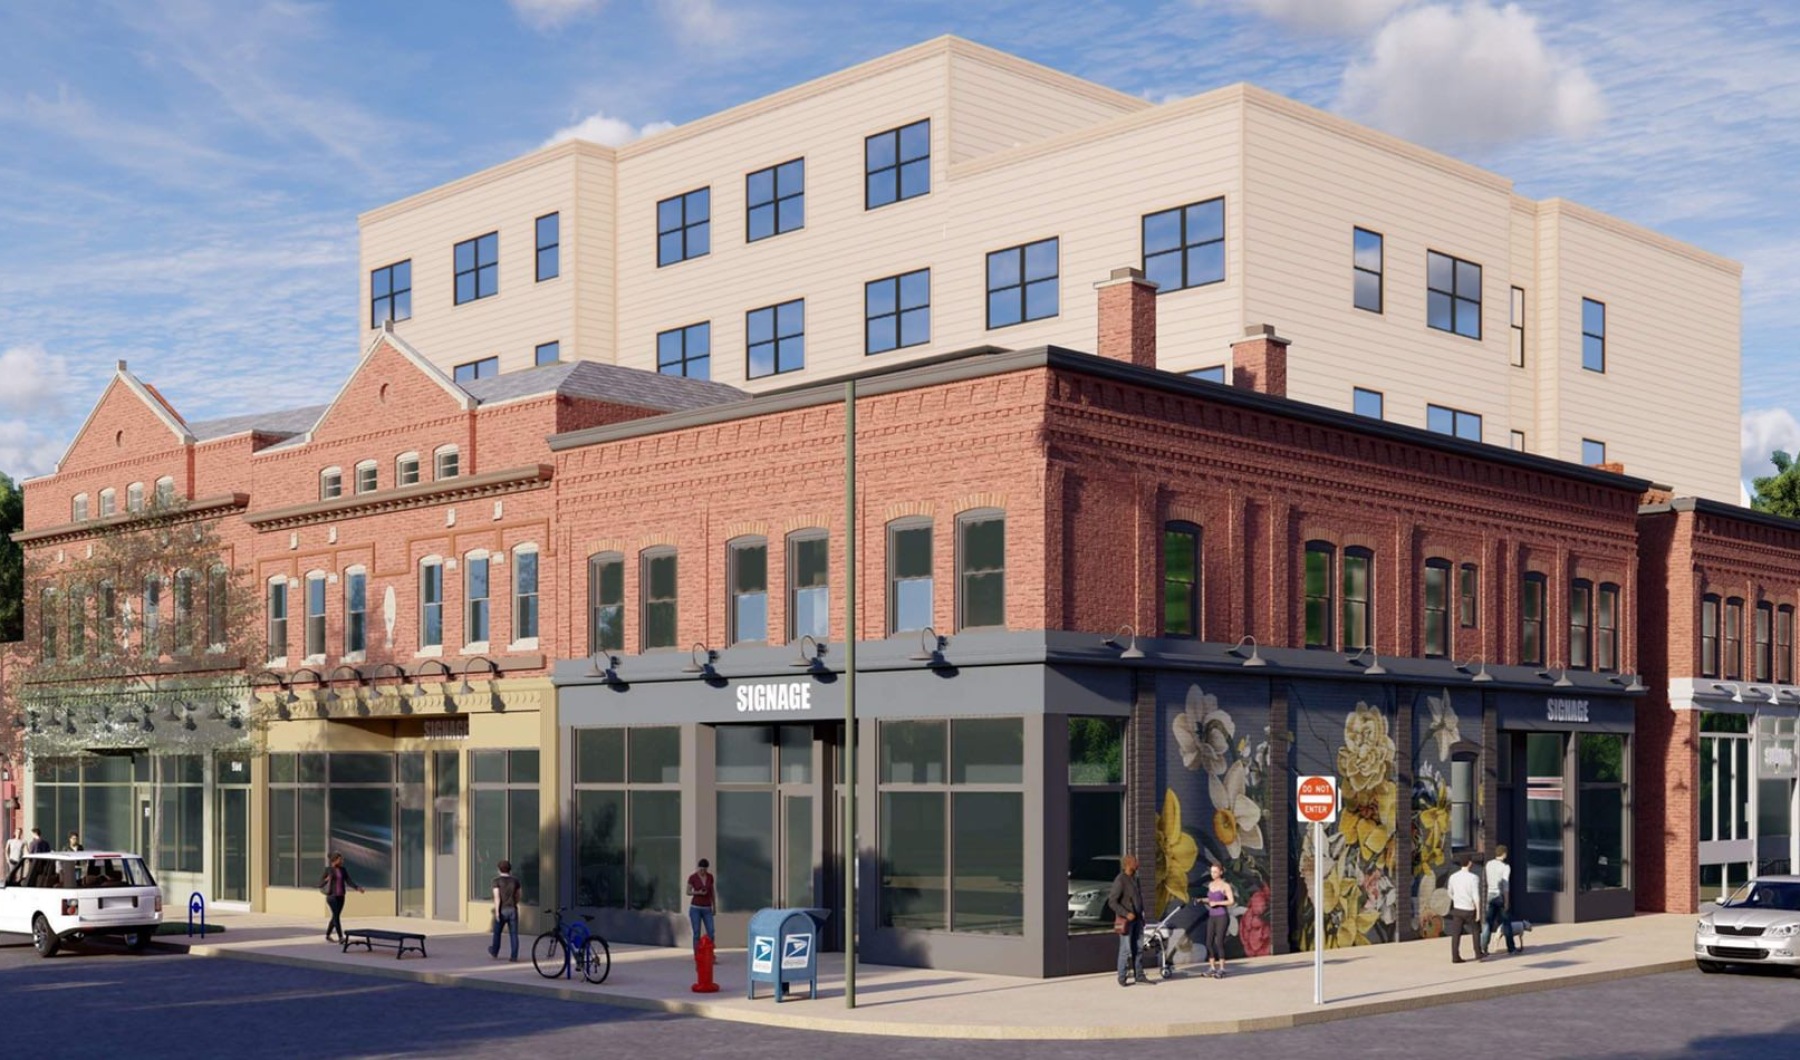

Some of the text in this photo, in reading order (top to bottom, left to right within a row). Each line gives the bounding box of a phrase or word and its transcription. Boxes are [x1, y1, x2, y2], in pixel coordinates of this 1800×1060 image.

[736, 682, 811, 712] SIGNAGE
[1547, 698, 1589, 722] SIGNAGE
[424, 720, 469, 740] SIGNAGE
[1302, 785, 1329, 793] DO NOT
[1305, 805, 1328, 813] ENTER
